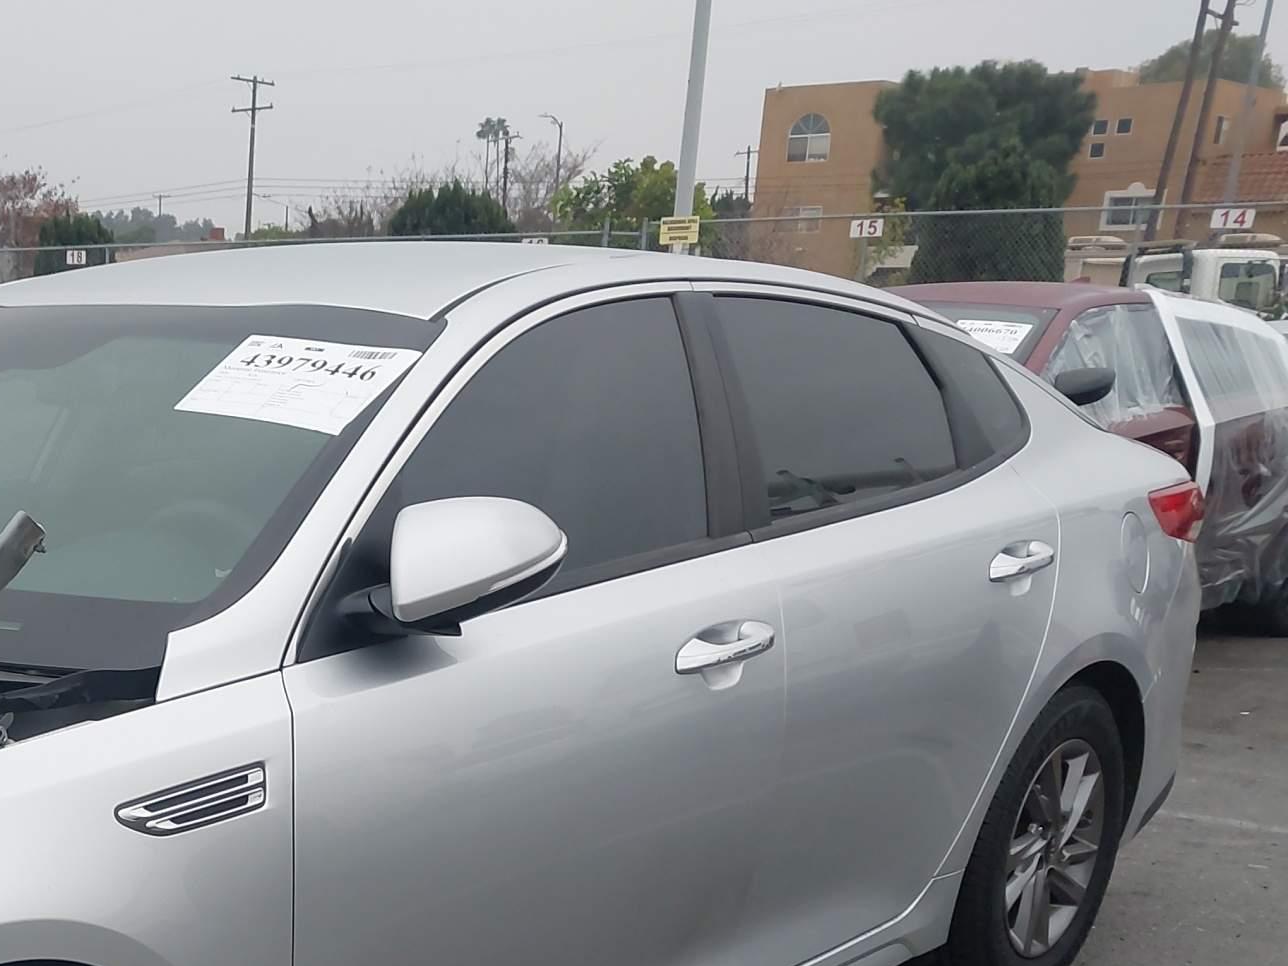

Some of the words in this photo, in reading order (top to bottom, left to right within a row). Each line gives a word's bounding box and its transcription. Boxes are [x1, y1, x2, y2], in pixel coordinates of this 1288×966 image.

[1220, 209, 1246, 227] 14
[857, 220, 878, 236] 15
[70, 251, 83, 264] 18
[240, 353, 383, 382] 43979446
